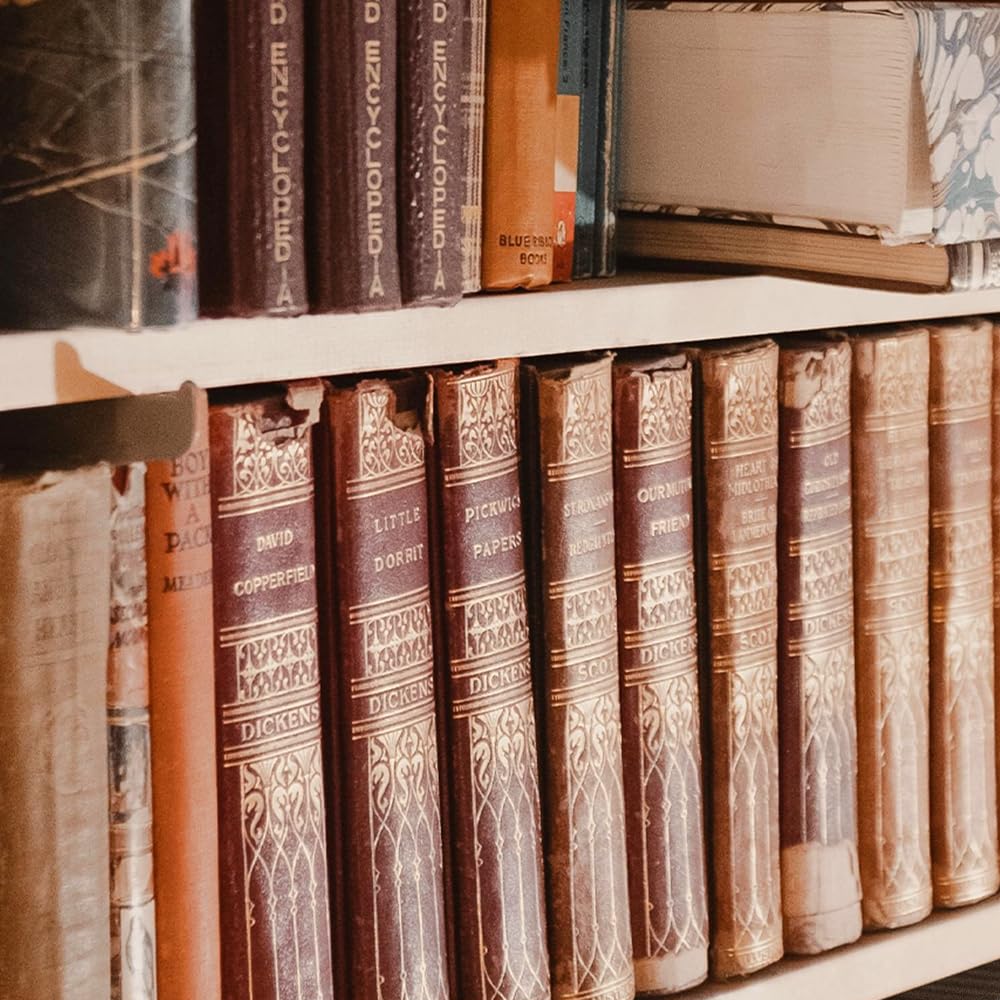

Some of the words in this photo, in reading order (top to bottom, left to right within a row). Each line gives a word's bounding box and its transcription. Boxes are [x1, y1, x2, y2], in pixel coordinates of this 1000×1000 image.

[270, 42, 293, 306] ENCYCLOPEDIA
[364, 40, 385, 298] ENCYCLOPEDIA
[433, 40, 447, 291] ENCYCLOPEDIA
[499, 234, 531, 247] BLUE
[637, 485, 666, 504] OUR
[374, 506, 421, 534] LITTLE
[465, 496, 521, 523] PICKWIC
[256, 529, 293, 553] DAVID
[473, 531, 523, 560] PAPERS
[374, 543, 424, 573] DORRIT
[368, 675, 434, 715] DICKENS
[241, 702, 320, 742] DICKENS
